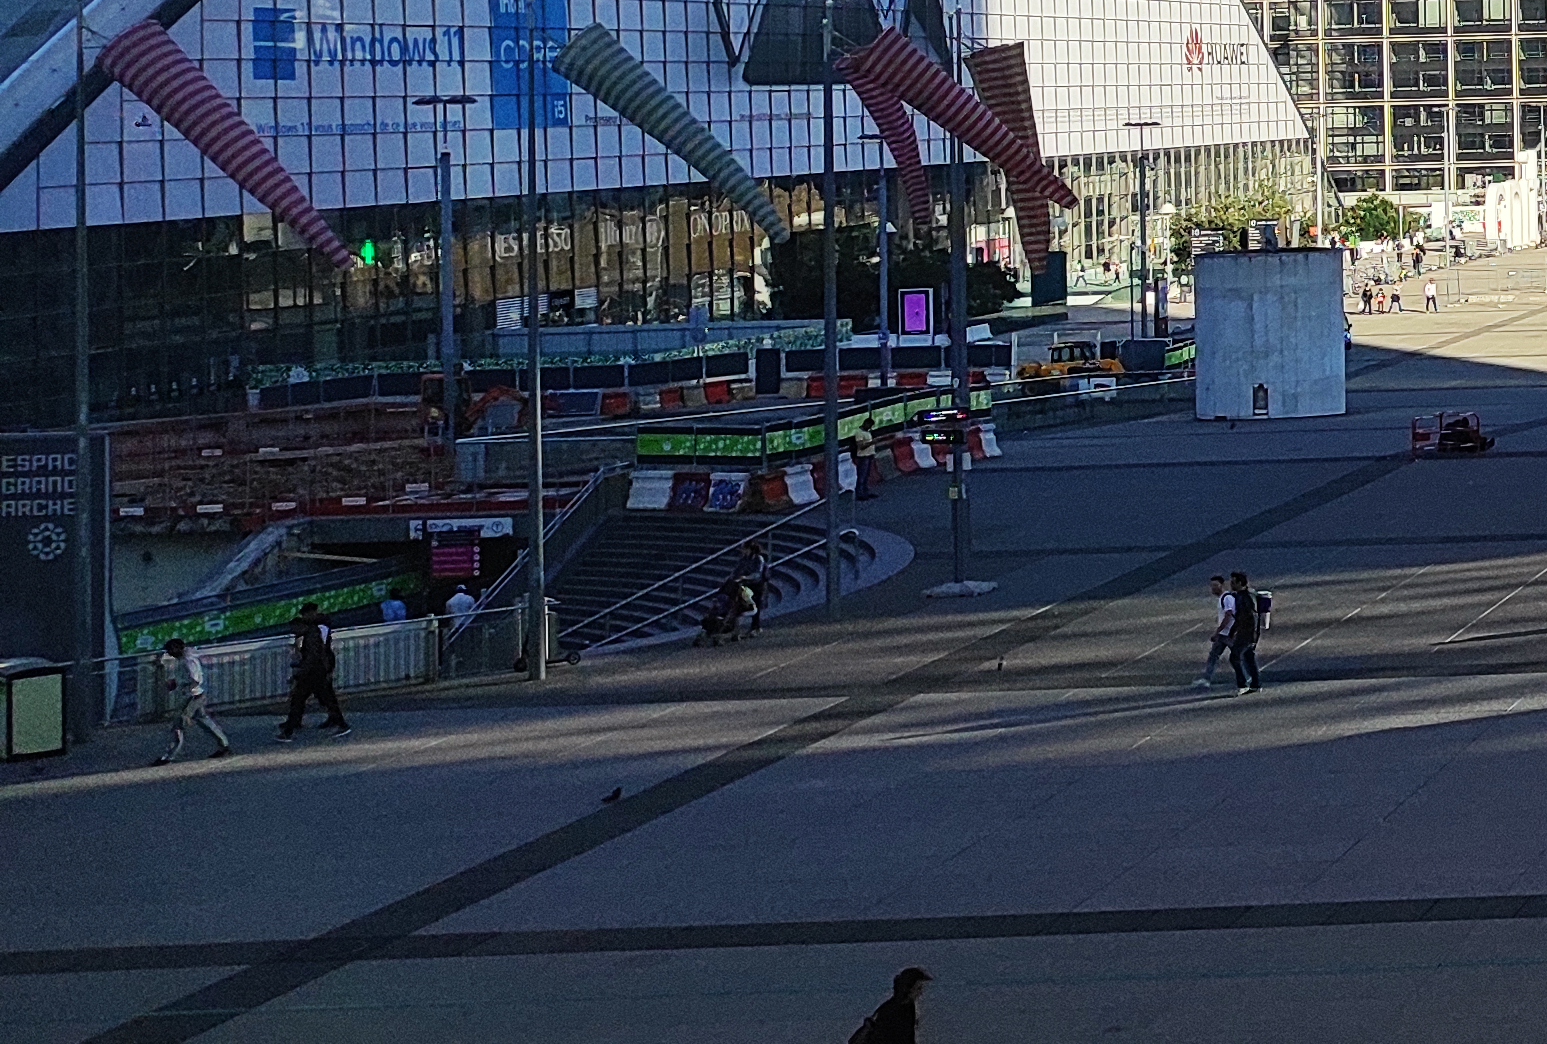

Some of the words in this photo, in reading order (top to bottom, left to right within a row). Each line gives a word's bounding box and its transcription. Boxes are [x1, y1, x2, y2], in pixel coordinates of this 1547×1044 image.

[309, 22, 440, 68] Windows
[442, 26, 465, 68] 11
[1207, 42, 1249, 66] HUAWEI
[1, 453, 79, 472] ESPAC
[1, 476, 78, 494] GRAND
[2, 498, 78, 516] ARCHE
